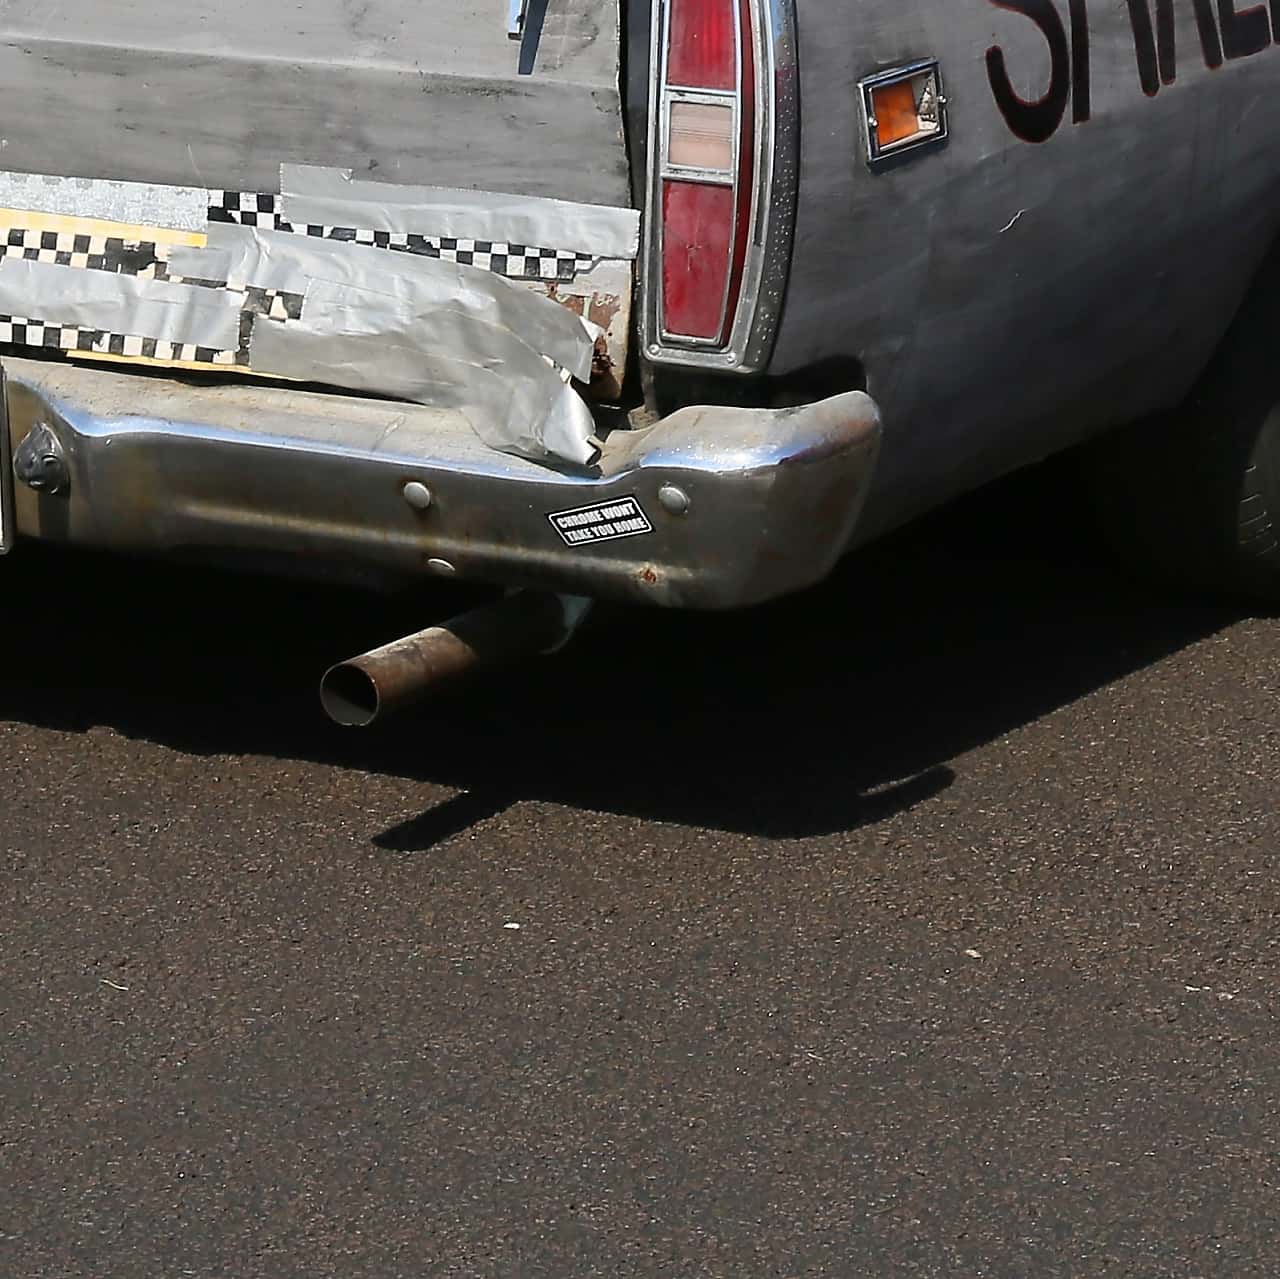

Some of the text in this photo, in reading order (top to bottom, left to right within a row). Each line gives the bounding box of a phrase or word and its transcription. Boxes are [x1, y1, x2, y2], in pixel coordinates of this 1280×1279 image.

[556, 502, 635, 528] CHROME WONT
[564, 517, 648, 542] TAKE YOU HOME
